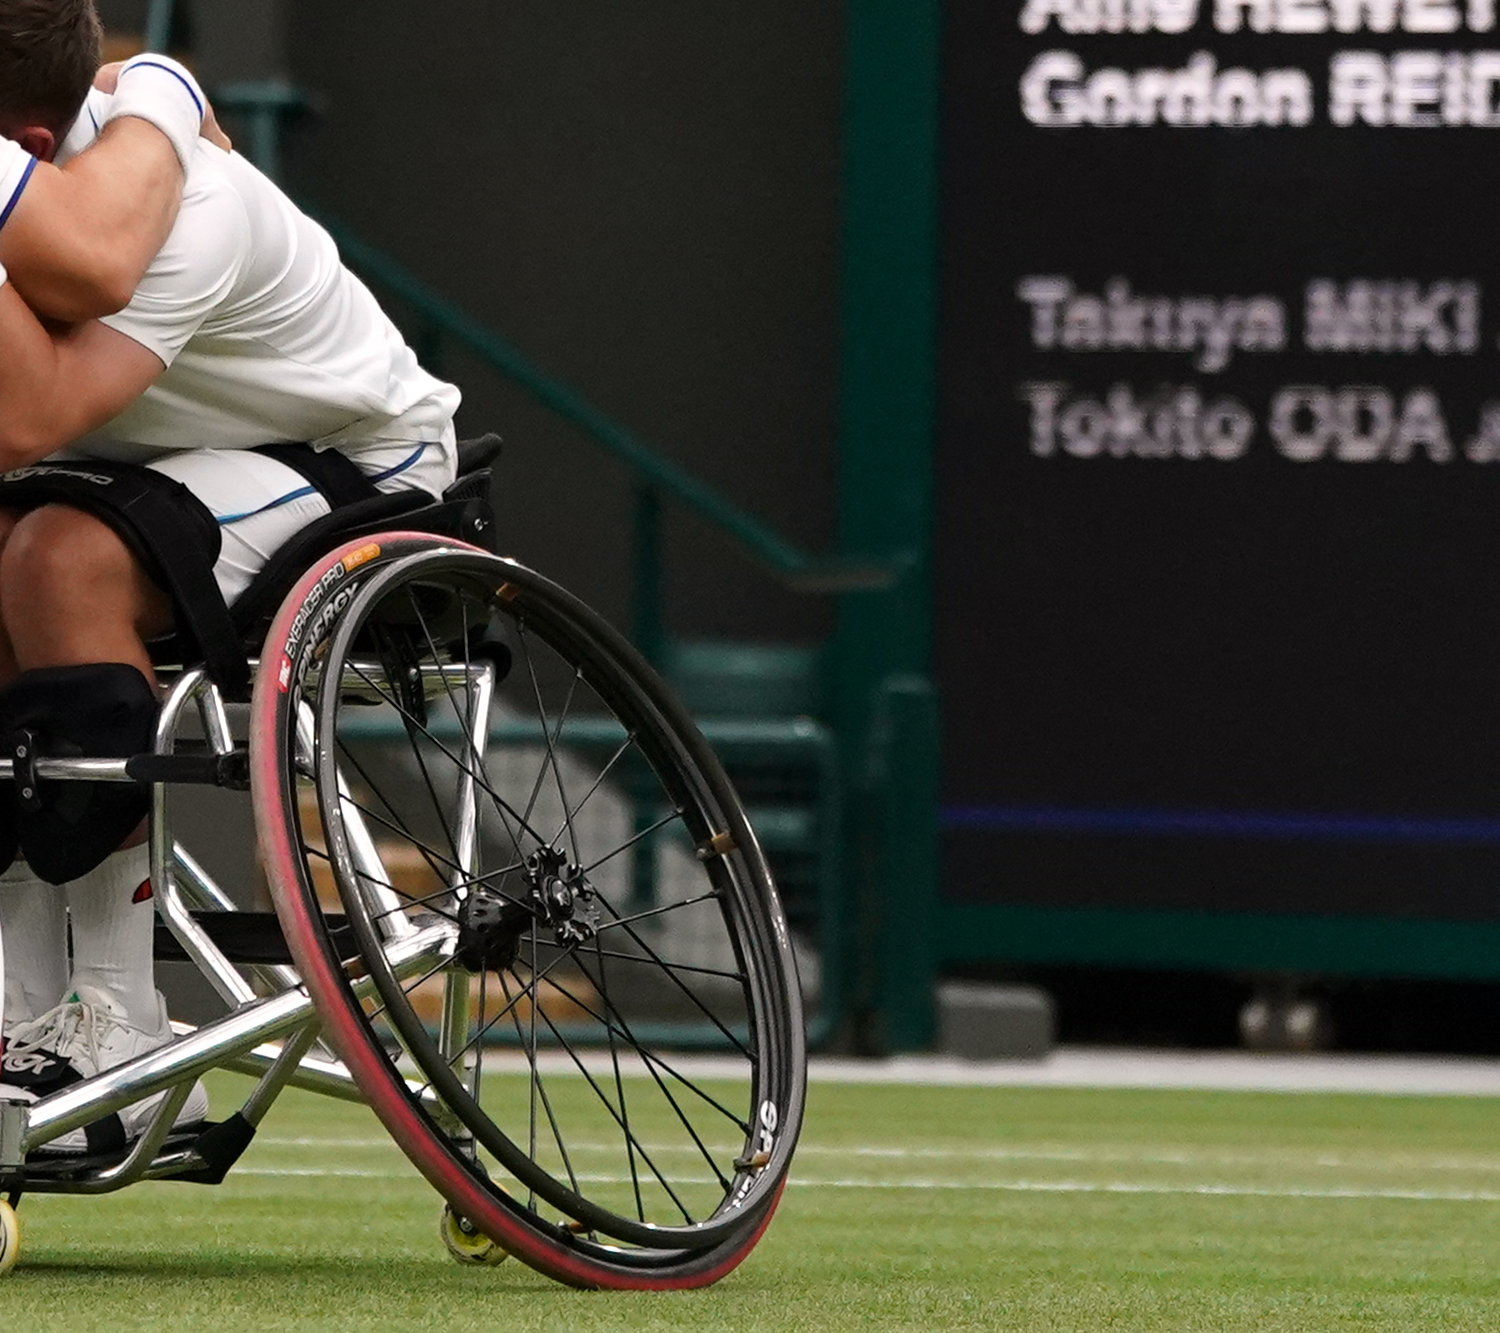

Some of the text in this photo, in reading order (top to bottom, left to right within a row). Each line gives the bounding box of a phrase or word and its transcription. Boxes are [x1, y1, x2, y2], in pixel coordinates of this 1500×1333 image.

[1019, 49, 1314, 128] Gordon
[1018, 277, 1287, 372] Takuya
[1303, 279, 1480, 353] MIKI
[1020, 383, 1255, 460] Tokito
[1269, 386, 1452, 461] ODA
